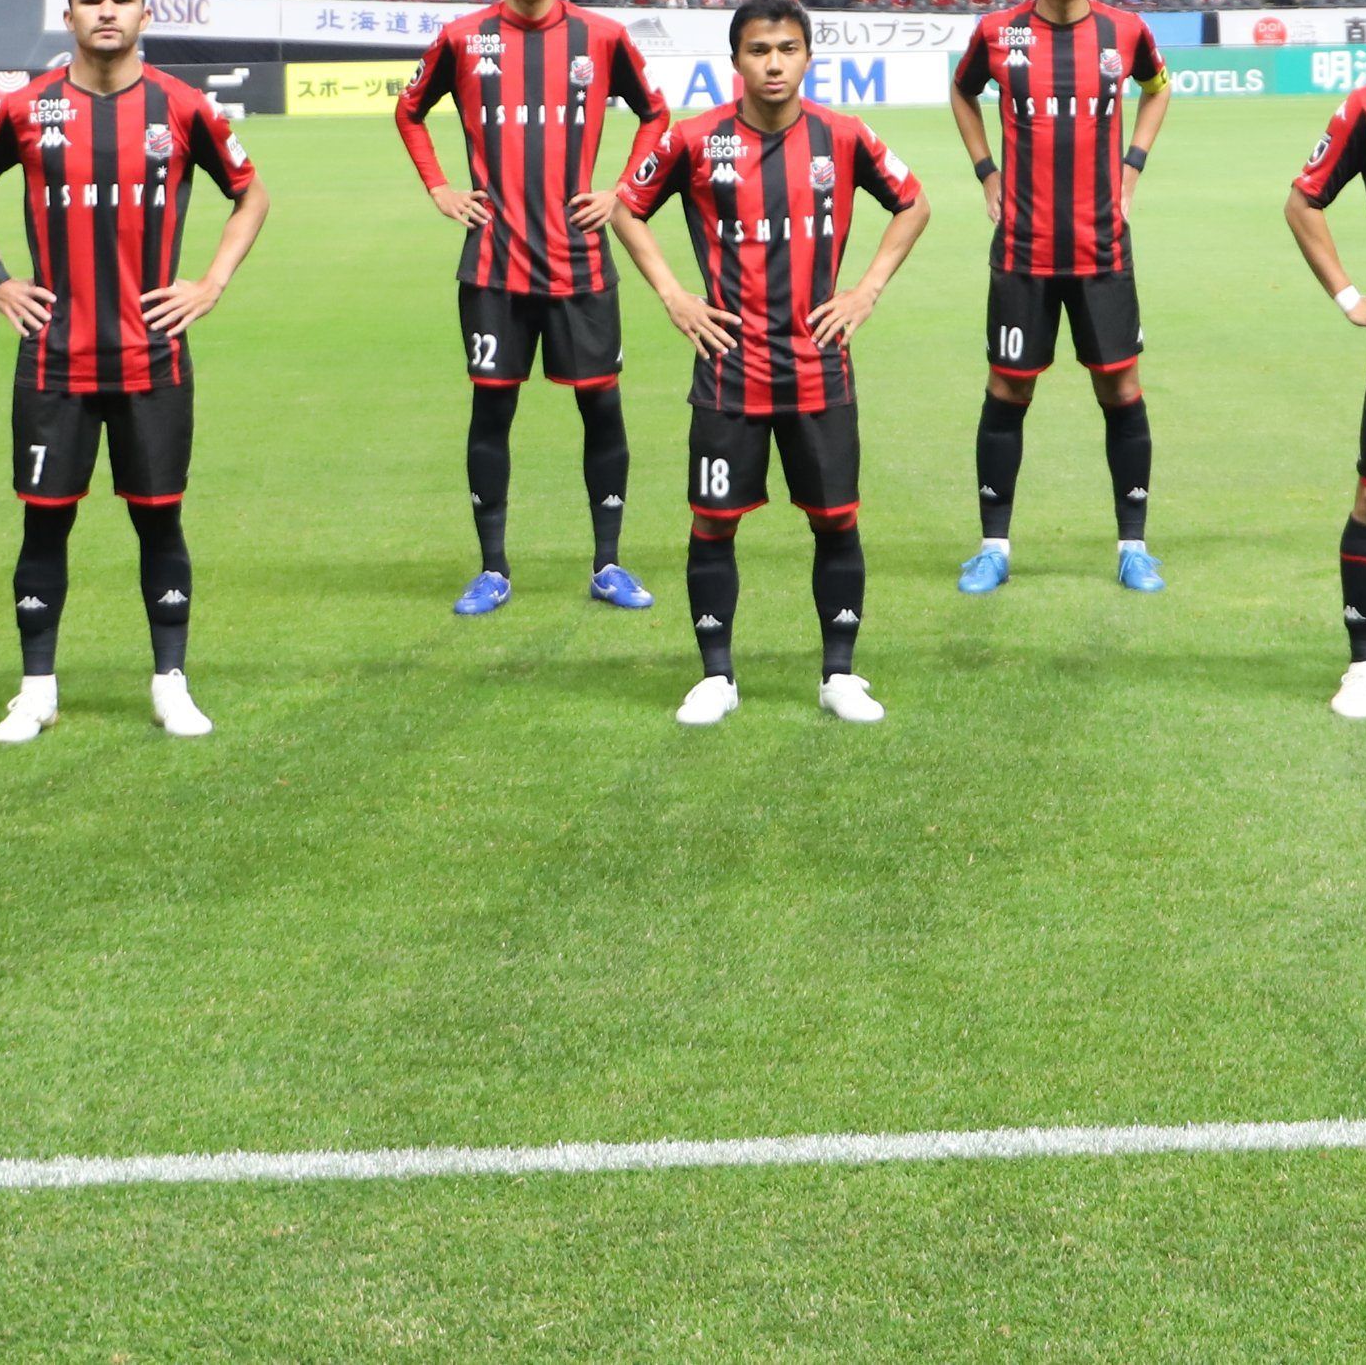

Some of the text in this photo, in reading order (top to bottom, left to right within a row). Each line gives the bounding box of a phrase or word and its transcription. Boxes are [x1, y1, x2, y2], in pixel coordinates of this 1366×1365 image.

[465, 34, 501, 44] TOHO
[998, 26, 1033, 36] TOHO
[466, 43, 507, 55] RESORT
[998, 36, 1038, 46] RESORT
[29, 98, 71, 110] TOHO
[1013, 96, 1116, 116] ISHIYA
[30, 109, 78, 124] RESORT
[481, 104, 585, 126] ISHIYA
[702, 134, 742, 146] TOHO
[703, 145, 749, 159] RESORT
[45, 183, 167, 208] ISHIYA
[715, 214, 834, 243] ISHIYA
[471, 332, 498, 370] 32
[999, 324, 1024, 362] 10
[29, 444, 48, 485] 7
[699, 455, 731, 498] 18
